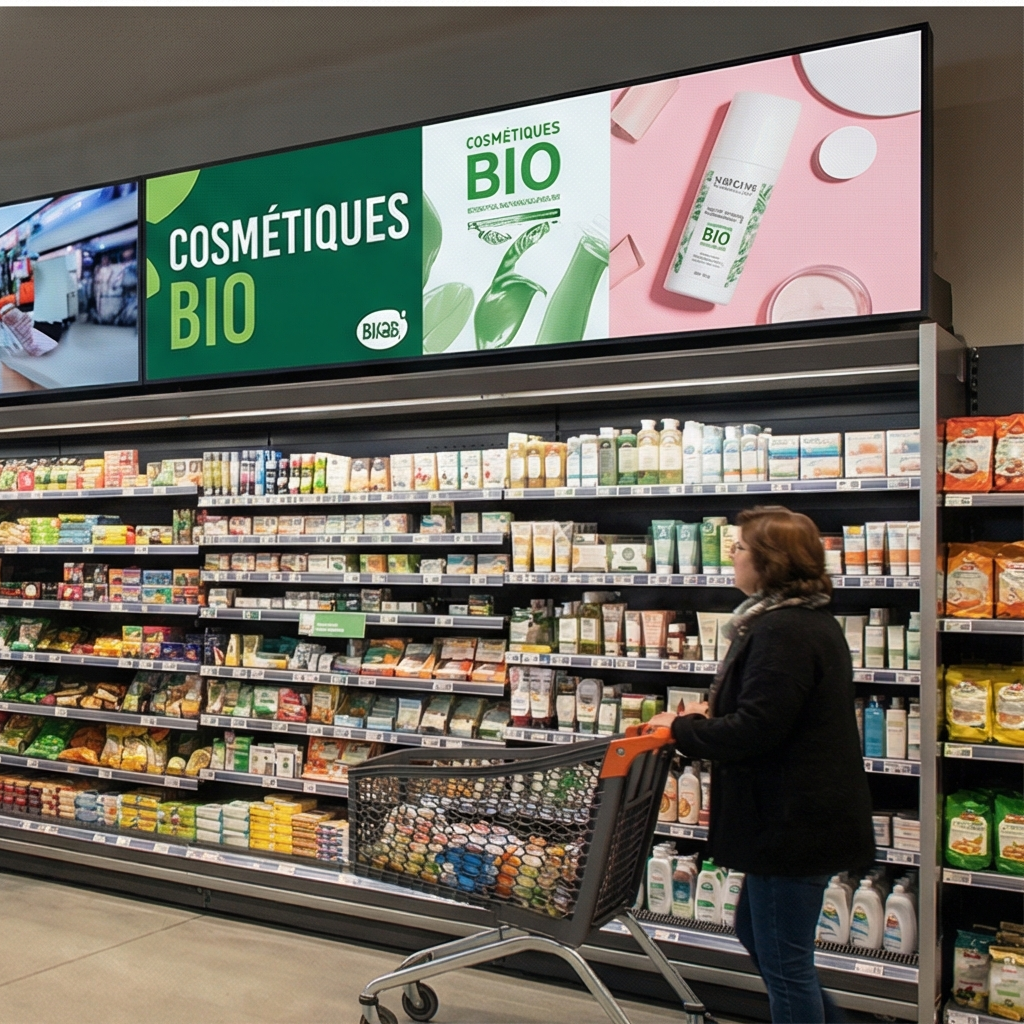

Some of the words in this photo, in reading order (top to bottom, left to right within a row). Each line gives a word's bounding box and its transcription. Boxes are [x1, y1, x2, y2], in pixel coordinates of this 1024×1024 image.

[467, 141, 561, 201] BIO
[169, 192, 410, 271] COSMÉTIQUES
[701, 226, 731, 246] BIO
[170, 271, 255, 350] BIO
